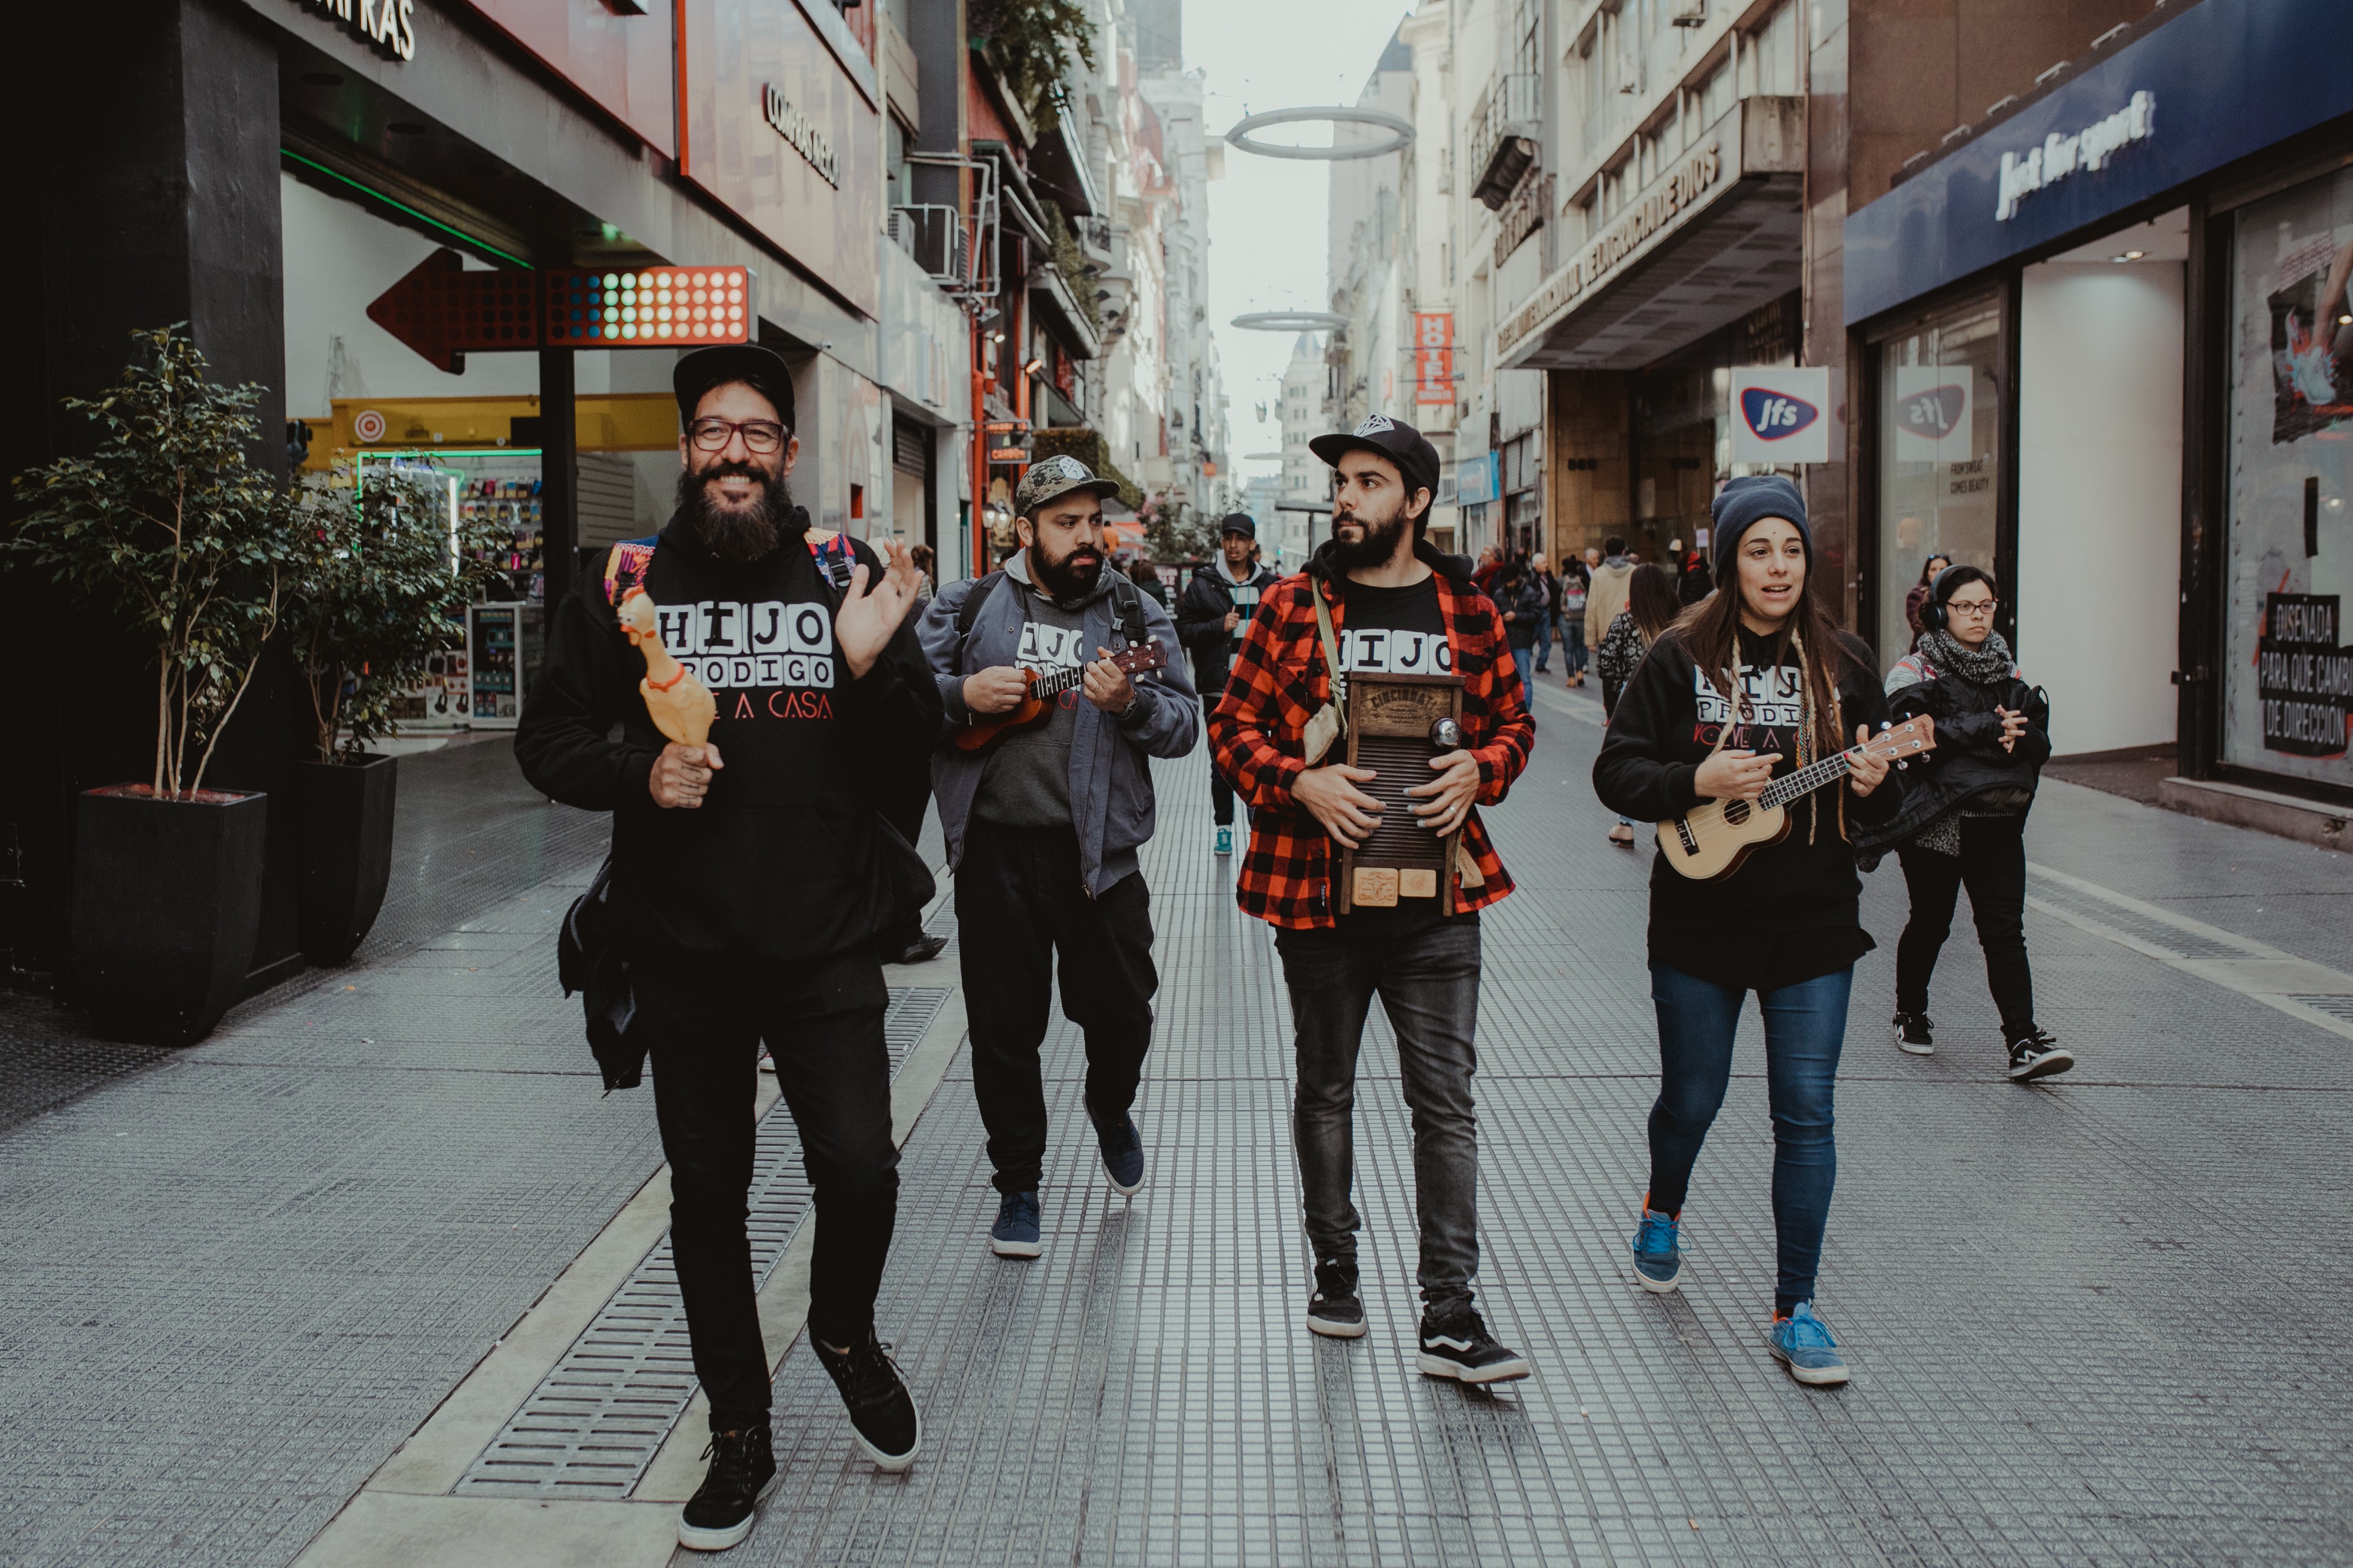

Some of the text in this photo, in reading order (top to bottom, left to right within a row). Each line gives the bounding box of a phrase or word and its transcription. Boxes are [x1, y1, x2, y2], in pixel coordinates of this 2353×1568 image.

[317, 0, 415, 61] RAS
[1677, 141, 1720, 208] DIOS
[1422, 317, 1445, 391] HOTEL
[1969, 477, 1989, 492] BEAUTY
[659, 608, 823, 648] HIJO
[2276, 596, 2332, 643] DISEÑADA
[1022, 627, 1083, 662] IJO
[684, 659, 829, 683] ODIGO
[2261, 652, 2288, 690] PARA
[2291, 653, 2314, 692] QUE
[734, 692, 754, 719] A
[768, 690, 834, 720] CASA
[1058, 689, 1079, 710] CA
[1699, 700, 1799, 723] PRODI
[1762, 726, 1781, 749] A
[2267, 696, 2346, 746] DE DIRECCIÓN
